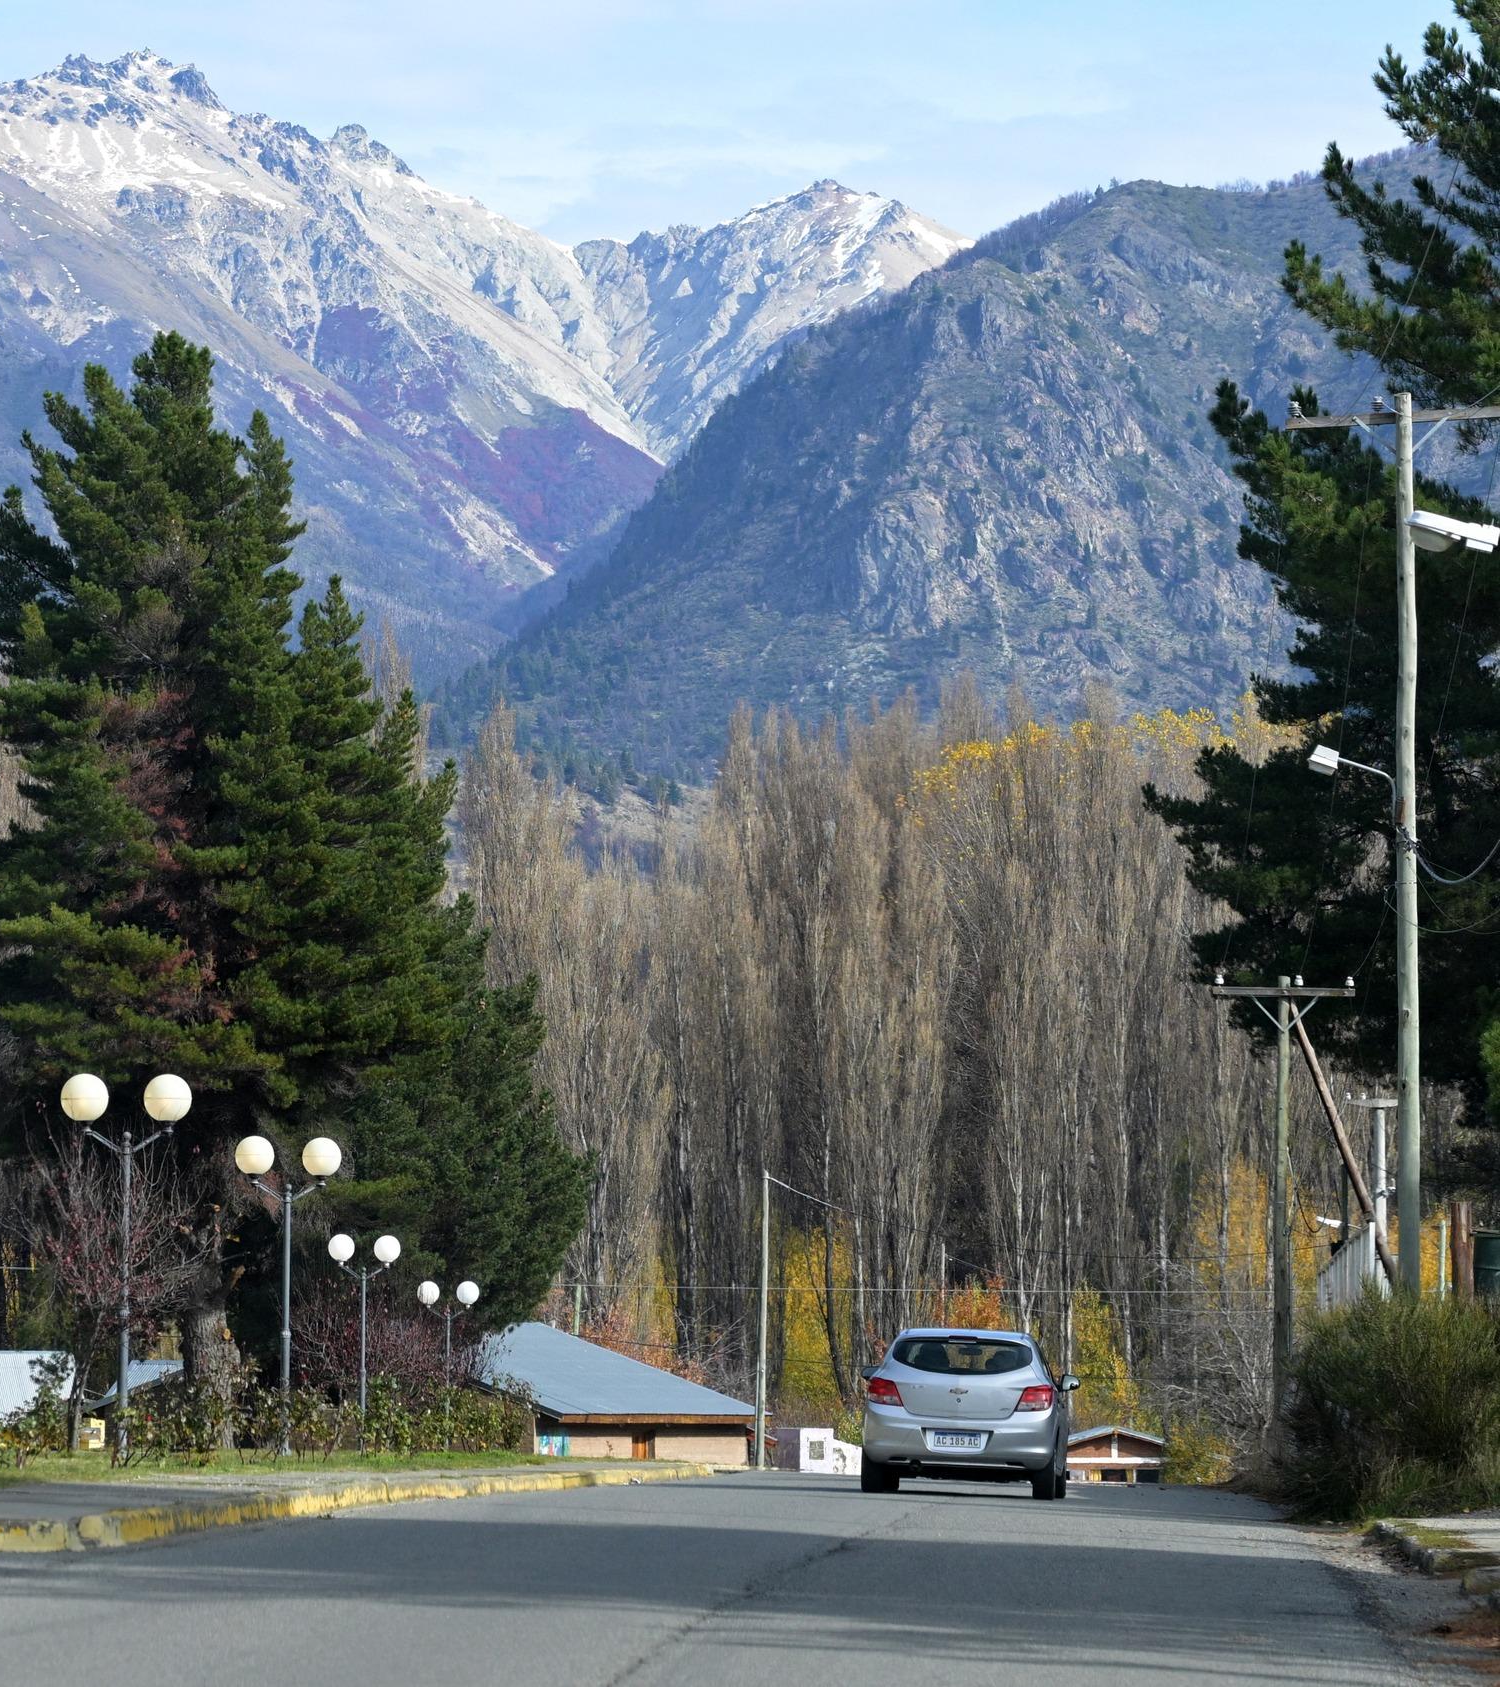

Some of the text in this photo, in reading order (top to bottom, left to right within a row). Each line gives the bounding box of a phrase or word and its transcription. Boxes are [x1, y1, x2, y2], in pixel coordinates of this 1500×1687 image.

[937, 1436, 978, 1446] AC 185 AC
